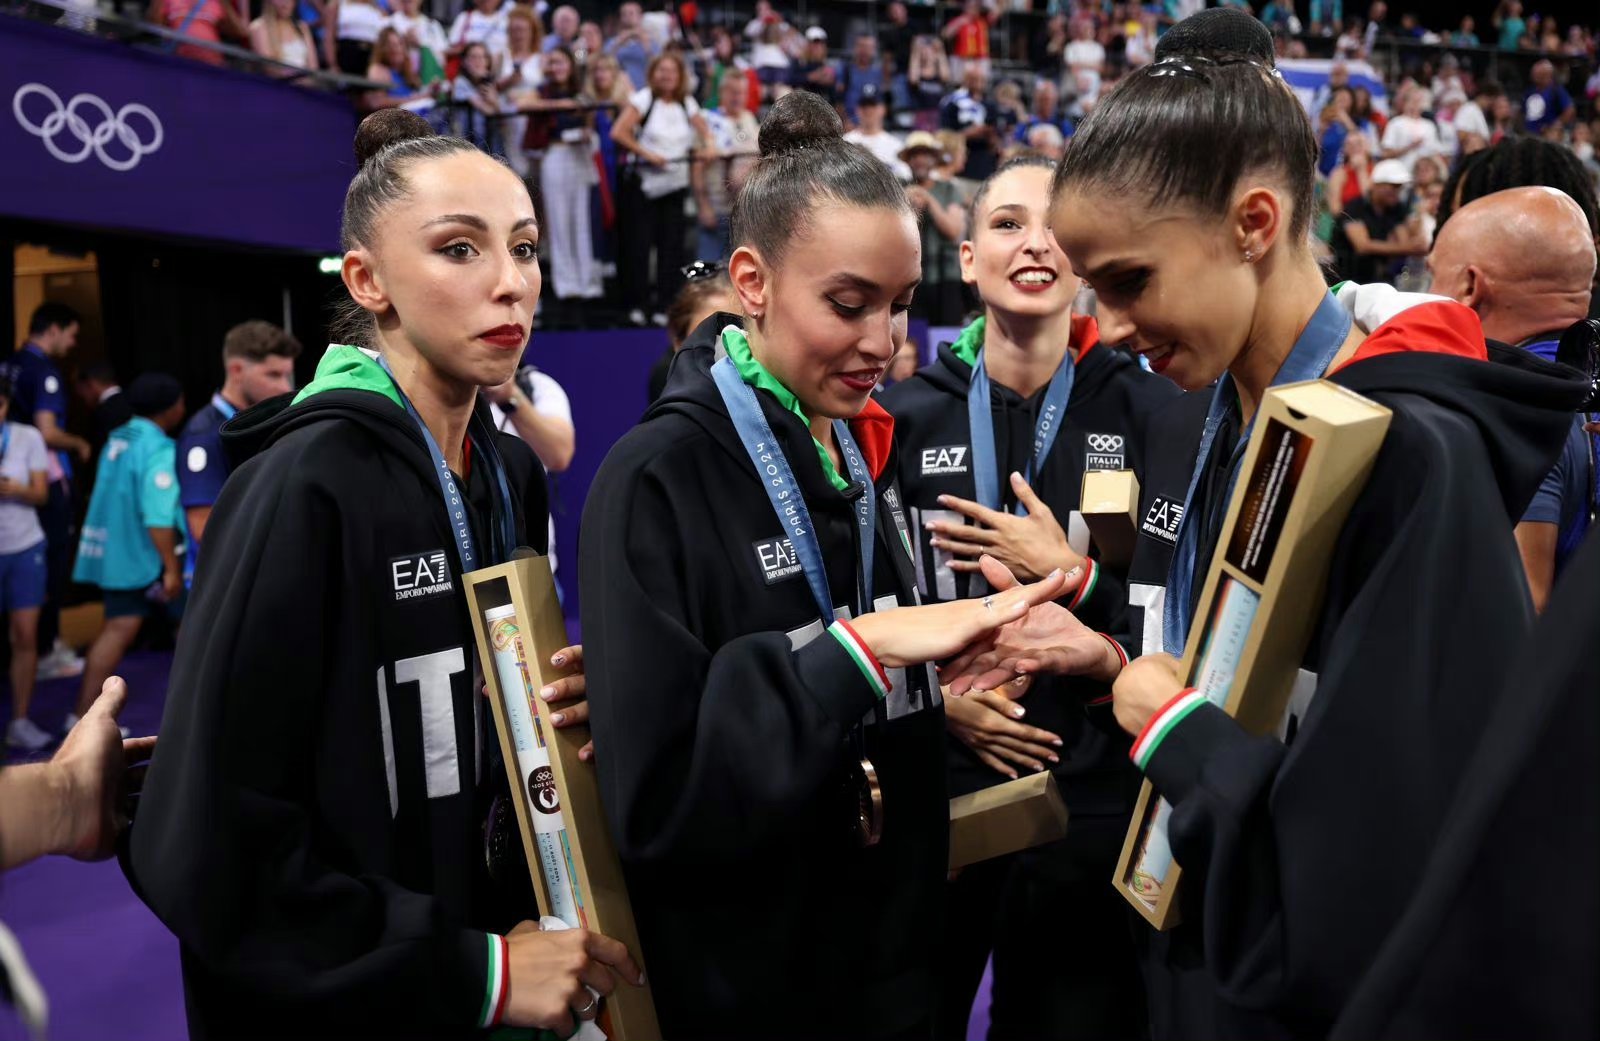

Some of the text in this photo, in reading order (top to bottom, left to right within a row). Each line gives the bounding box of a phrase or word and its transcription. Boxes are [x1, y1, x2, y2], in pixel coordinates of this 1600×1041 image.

[1039, 404, 1056, 438] 2024
[756, 442, 783, 487] 2024
[843, 438, 863, 476] 2024
[922, 447, 967, 468] EA7
[1089, 457, 1120, 465] ITALIA
[778, 490, 807, 537] PARIS
[1146, 497, 1184, 531] EA7
[456, 511, 472, 561] PARIS
[392, 553, 445, 590] EA7
[757, 538, 796, 571] EA7
[395, 587, 426, 601] EMPORIO
